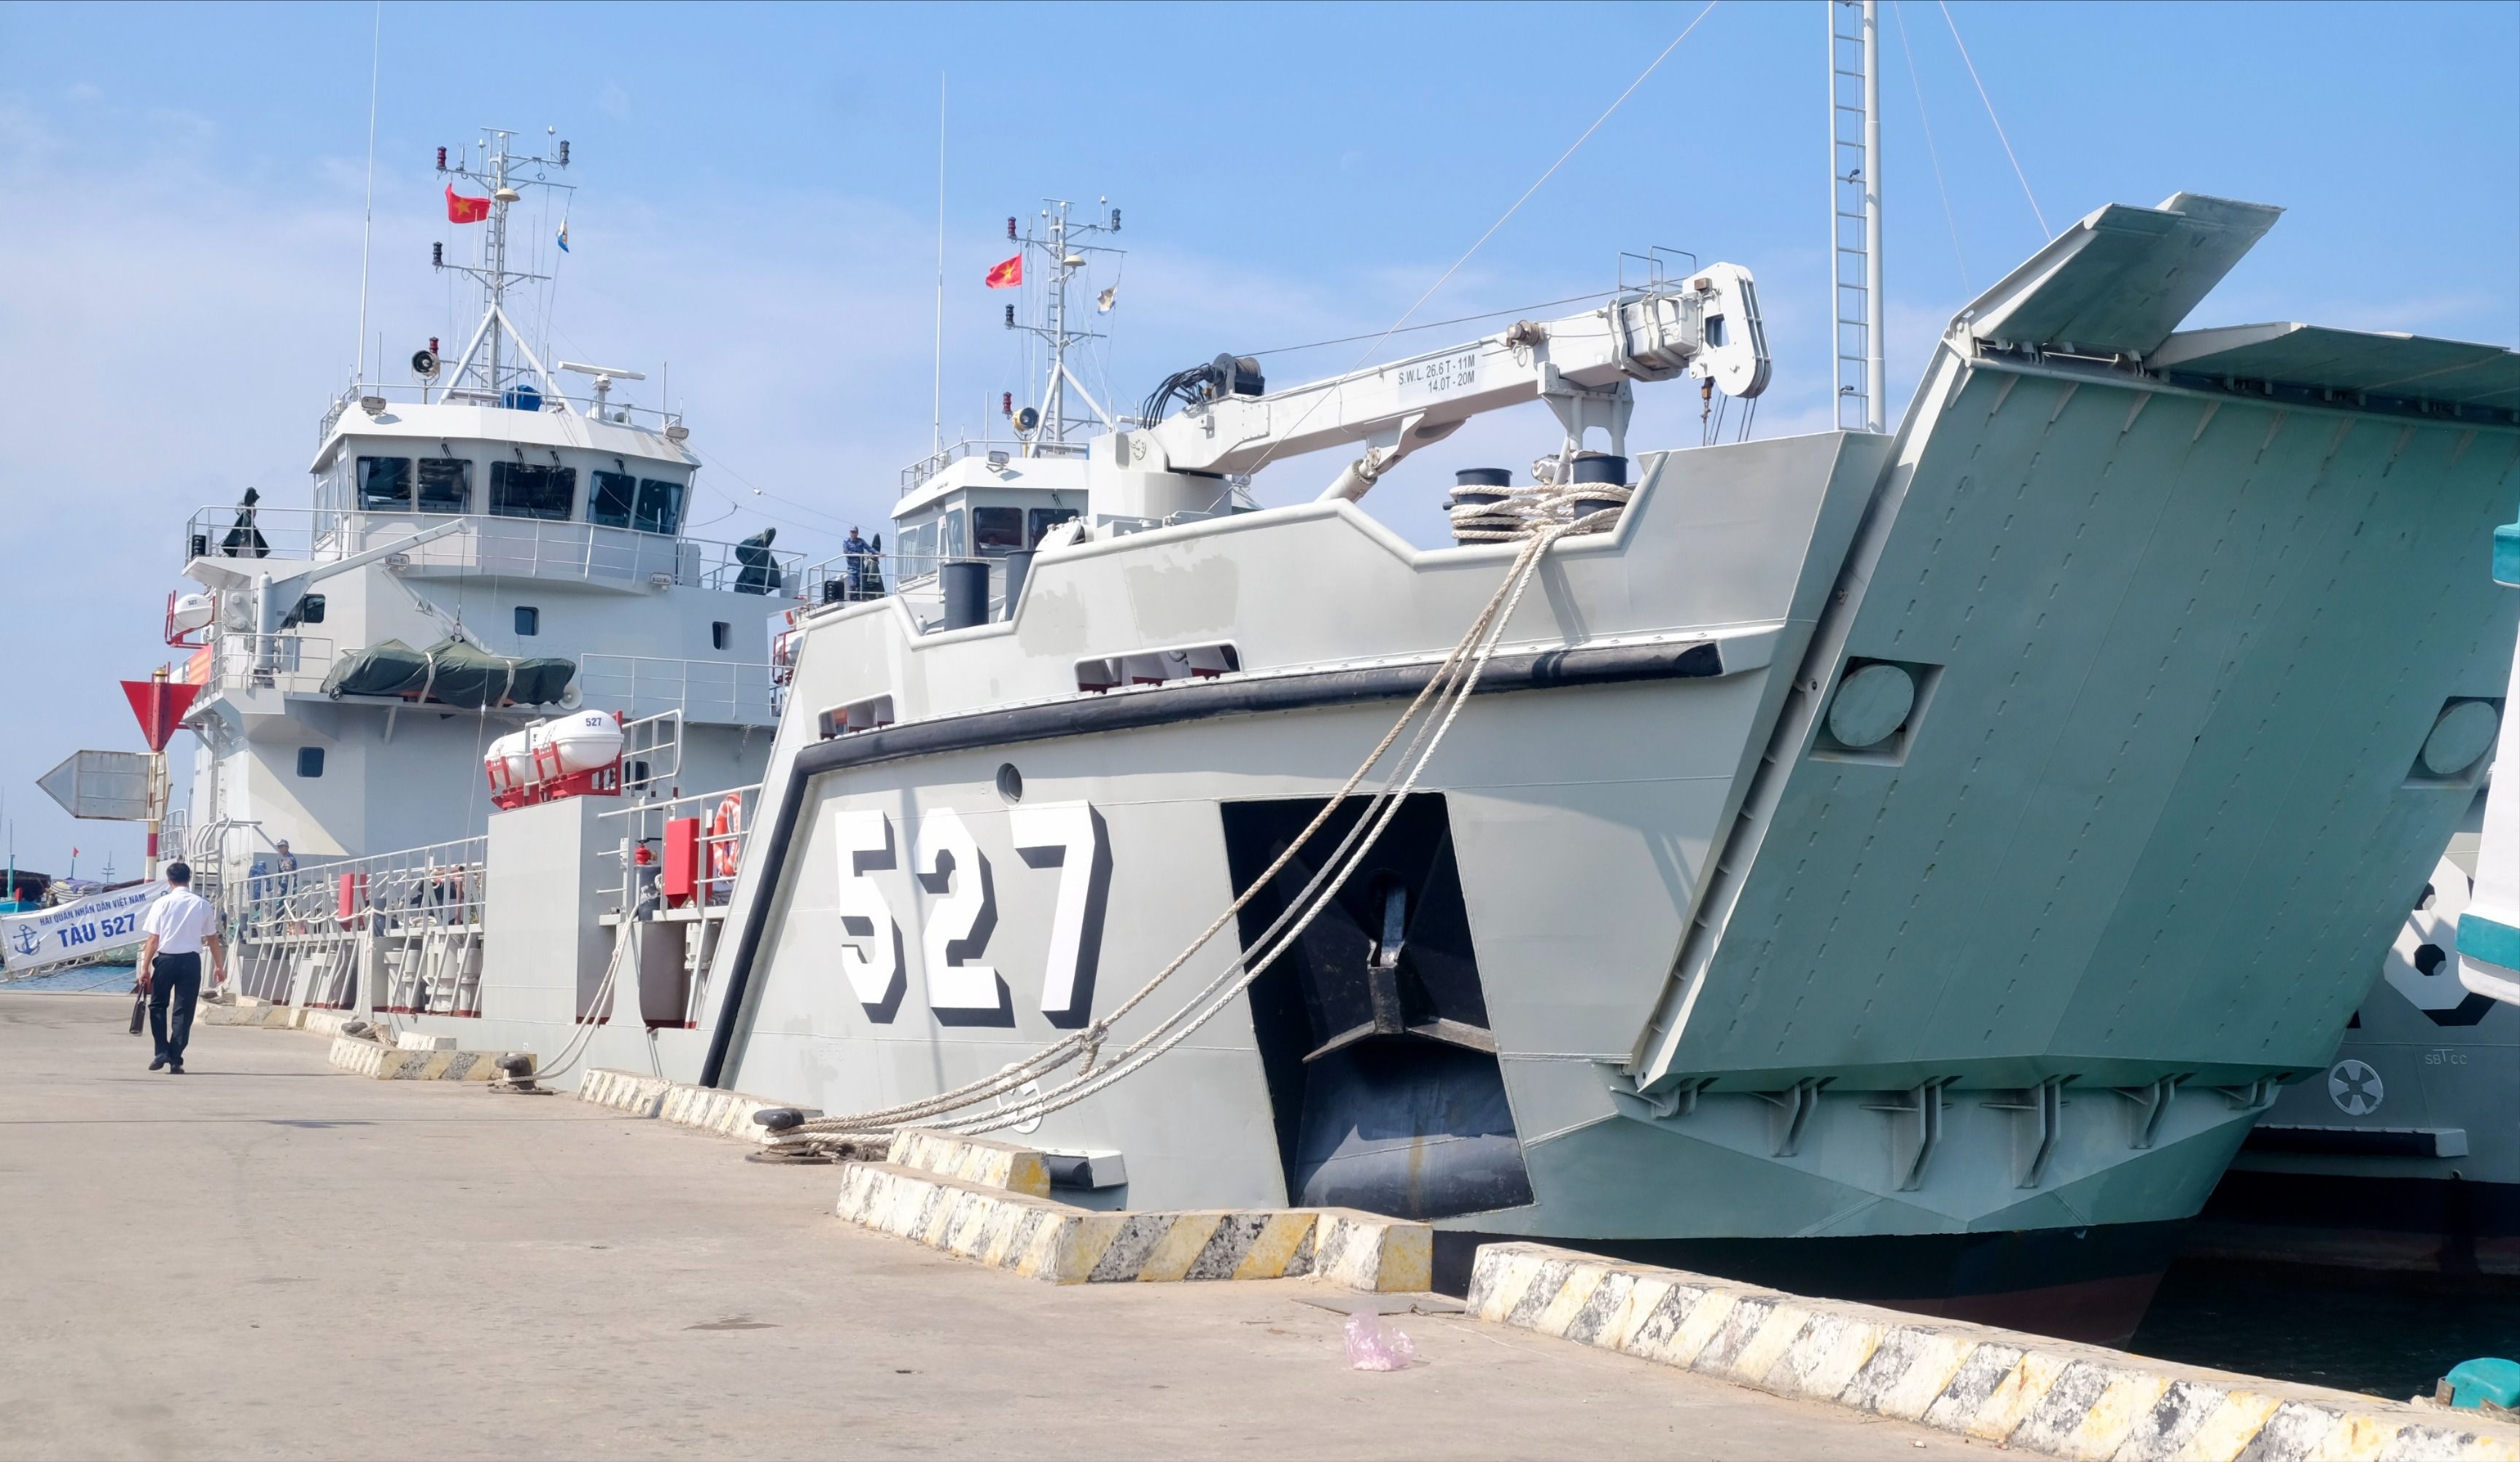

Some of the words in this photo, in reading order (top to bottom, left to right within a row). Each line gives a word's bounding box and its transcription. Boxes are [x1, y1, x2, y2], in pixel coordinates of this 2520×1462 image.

[1399, 368, 1424, 385] S.W.L.
[1426, 362, 1444, 378] 26.6
[1458, 354, 1475, 370] 11M
[1428, 376, 1451, 393] 14.0T
[1458, 370, 1474, 386] 20M
[586, 718, 602, 727] 527
[74, 904, 96, 917] NHÂN
[96, 900, 112, 912] DÂN
[112, 896, 128, 909] VIỆT
[128, 893, 146, 904] NAM
[835, 799, 1114, 1030] 527
[57, 923, 96, 948] TÀU
[101, 912, 136, 938] 527
